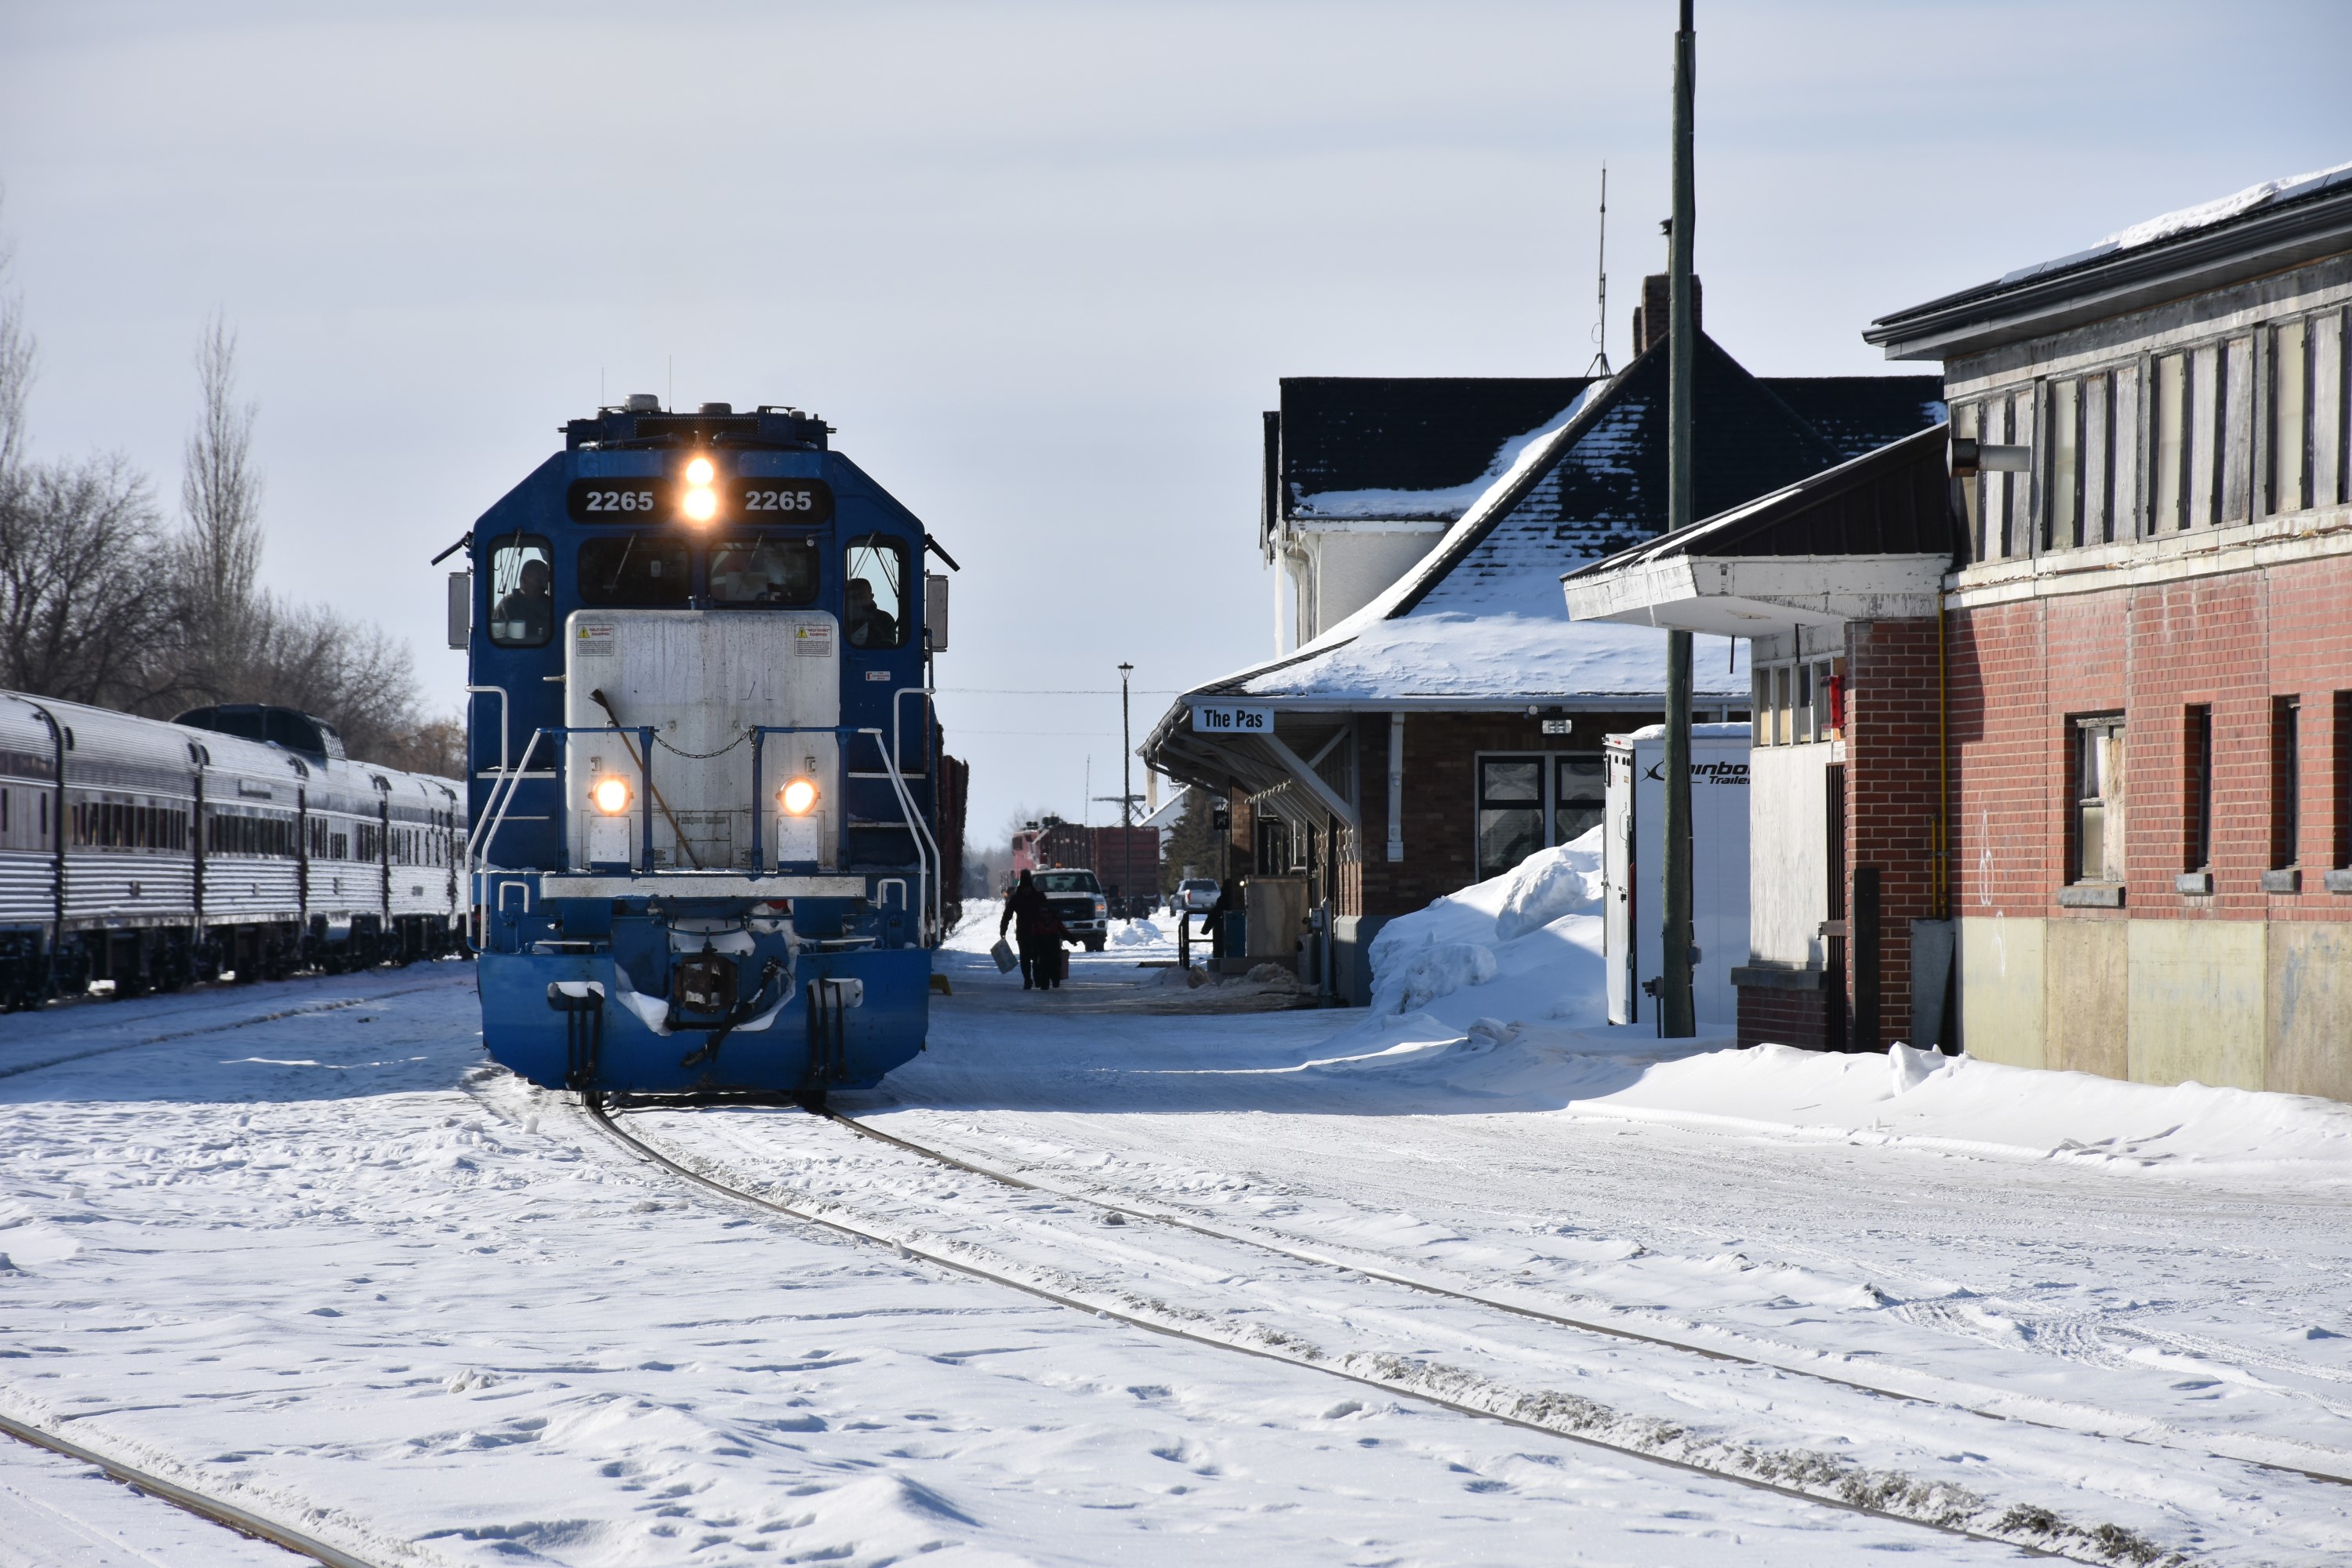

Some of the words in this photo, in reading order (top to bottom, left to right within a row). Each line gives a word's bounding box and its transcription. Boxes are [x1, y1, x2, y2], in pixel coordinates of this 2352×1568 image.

[586, 491, 654, 511] 2265
[745, 491, 811, 510] 2265
[1203, 710, 1231, 728] The
[1236, 710, 1263, 728] Pas
[1691, 761, 1750, 775] inbo
